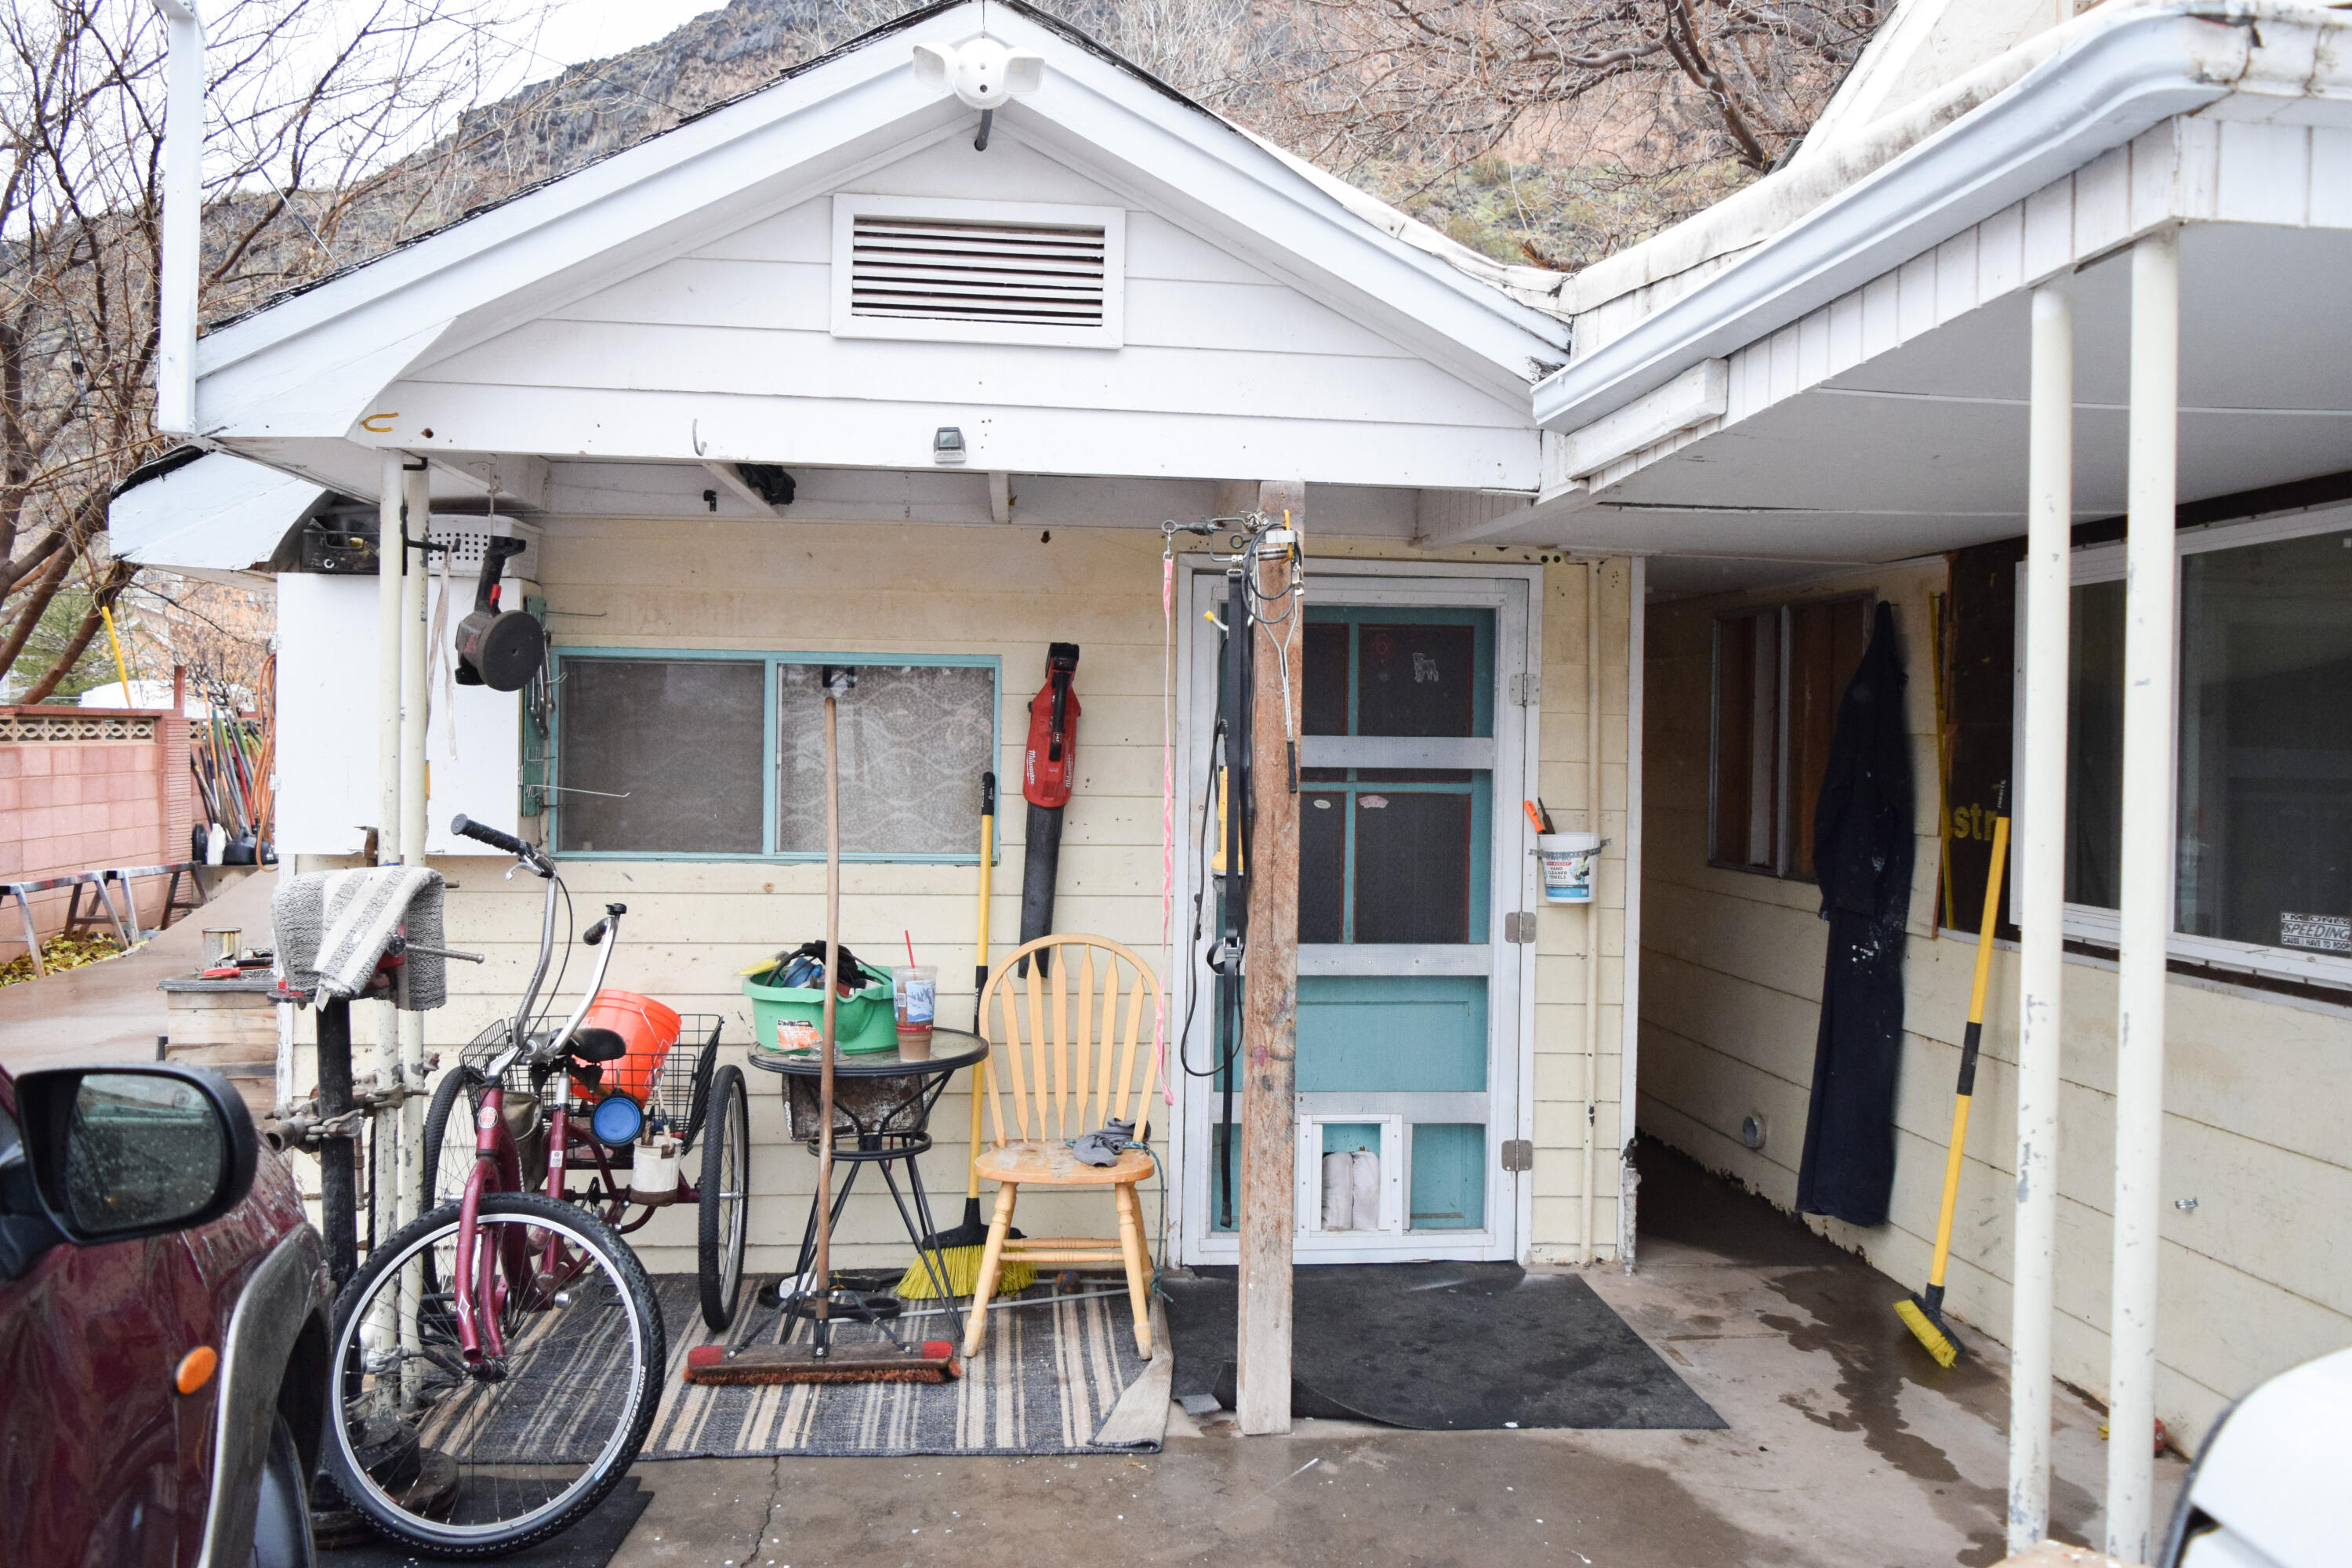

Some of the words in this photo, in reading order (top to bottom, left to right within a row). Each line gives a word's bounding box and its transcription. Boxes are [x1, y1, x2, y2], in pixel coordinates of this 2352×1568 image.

[2310, 916, 2350, 925] ONLY
[2282, 922, 2352, 941] SPEEDING
[2307, 939, 2321, 948] HAVE
[626, 1366, 646, 1432] BONTRAGER
